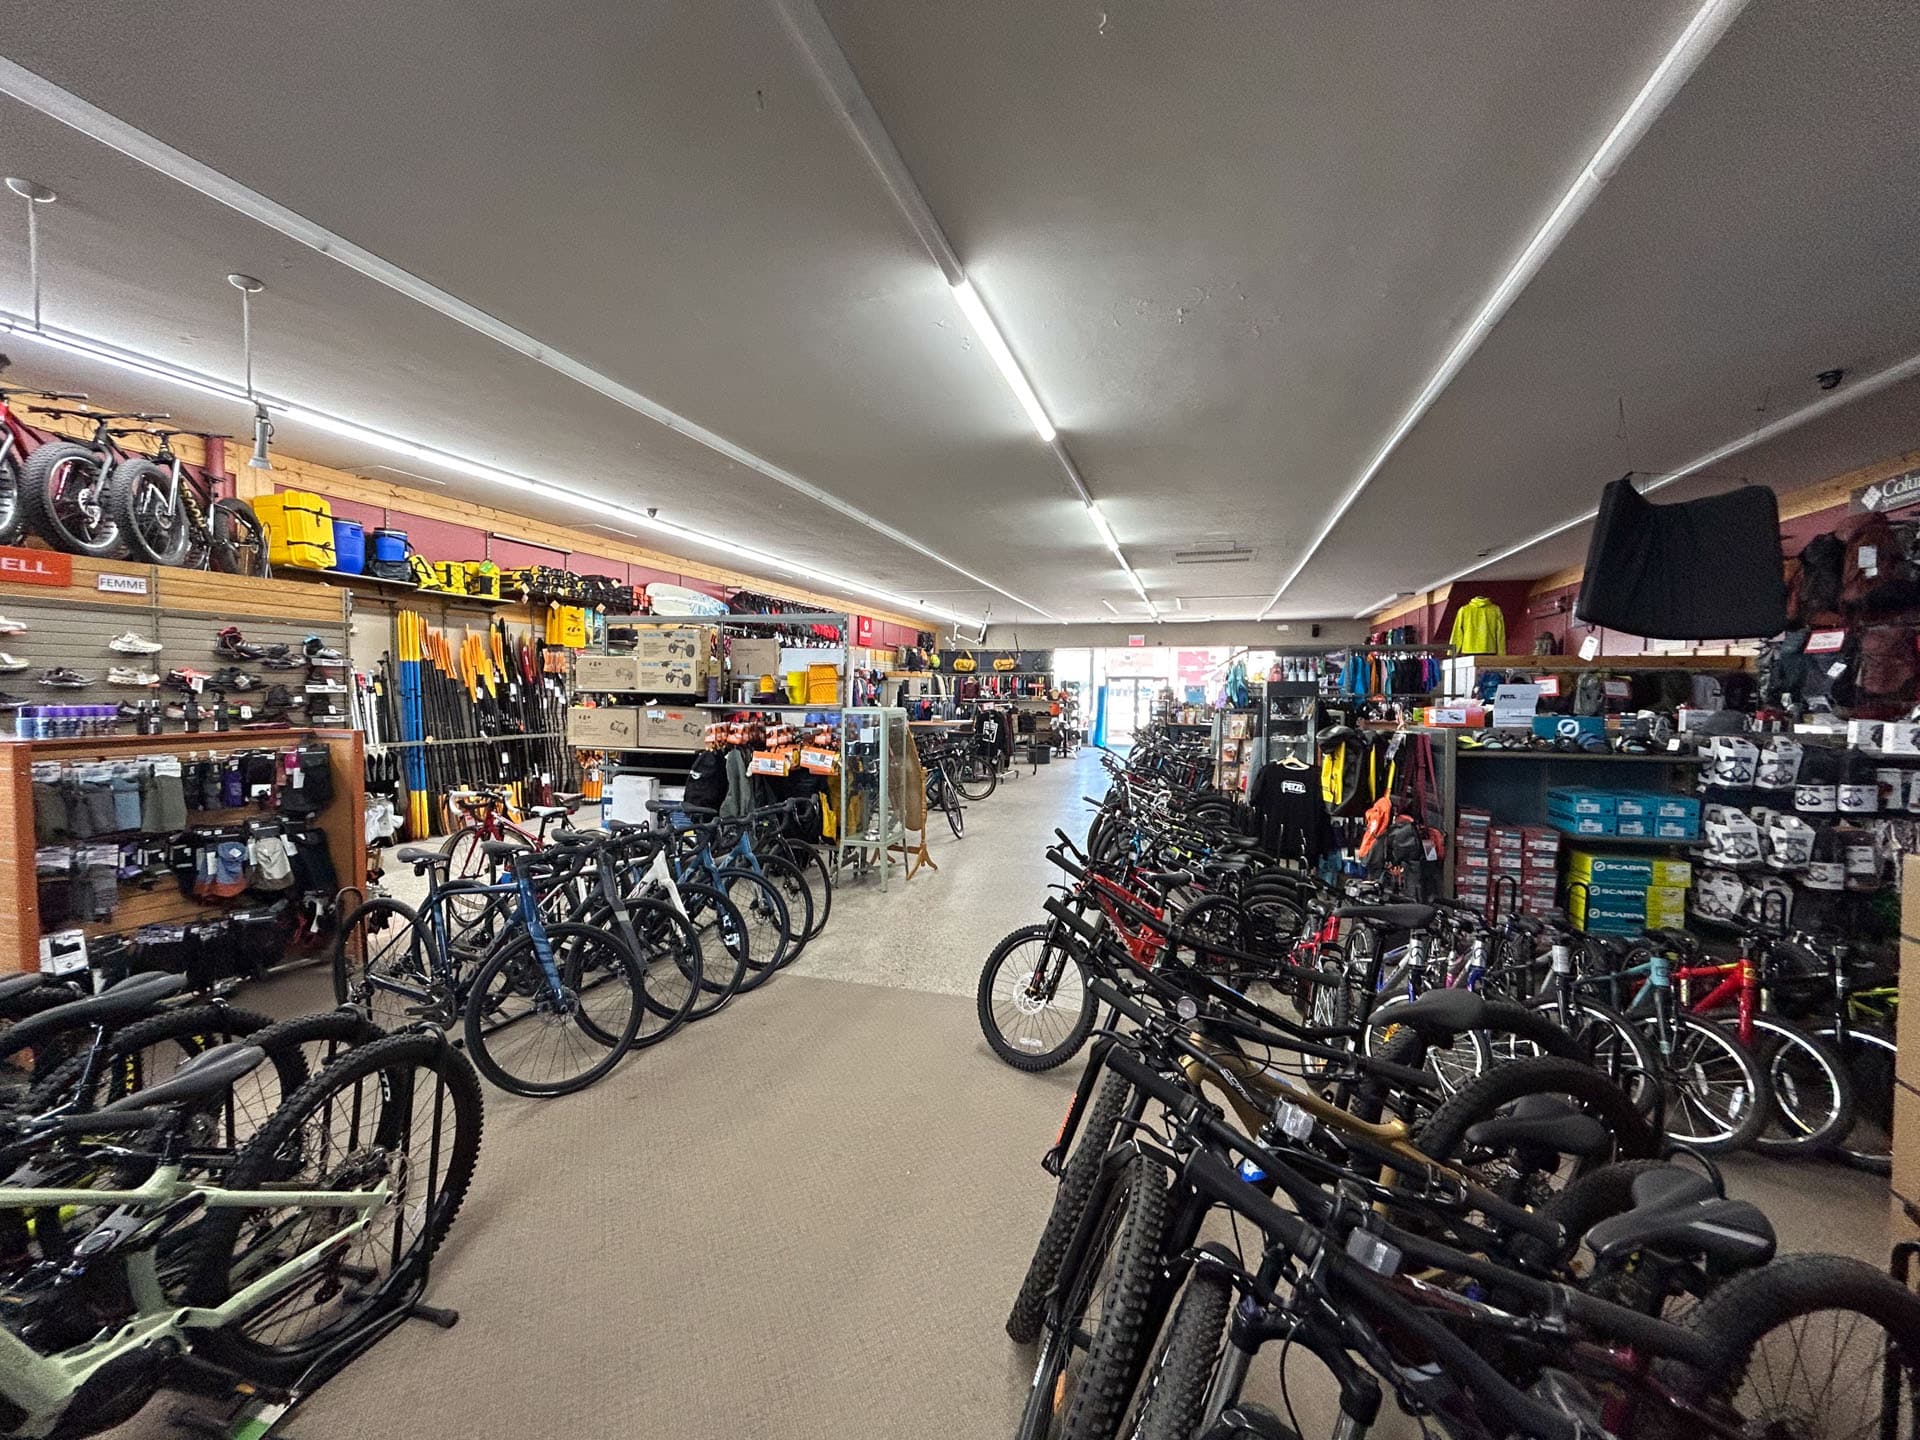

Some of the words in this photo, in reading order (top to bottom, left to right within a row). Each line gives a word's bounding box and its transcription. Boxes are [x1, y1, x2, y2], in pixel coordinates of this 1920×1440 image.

[100, 577, 147, 590] FEMME
[1606, 864, 1651, 872] SCARPA
[1601, 888, 1645, 896] SCARPA
[1601, 911, 1645, 920] SCARPA
